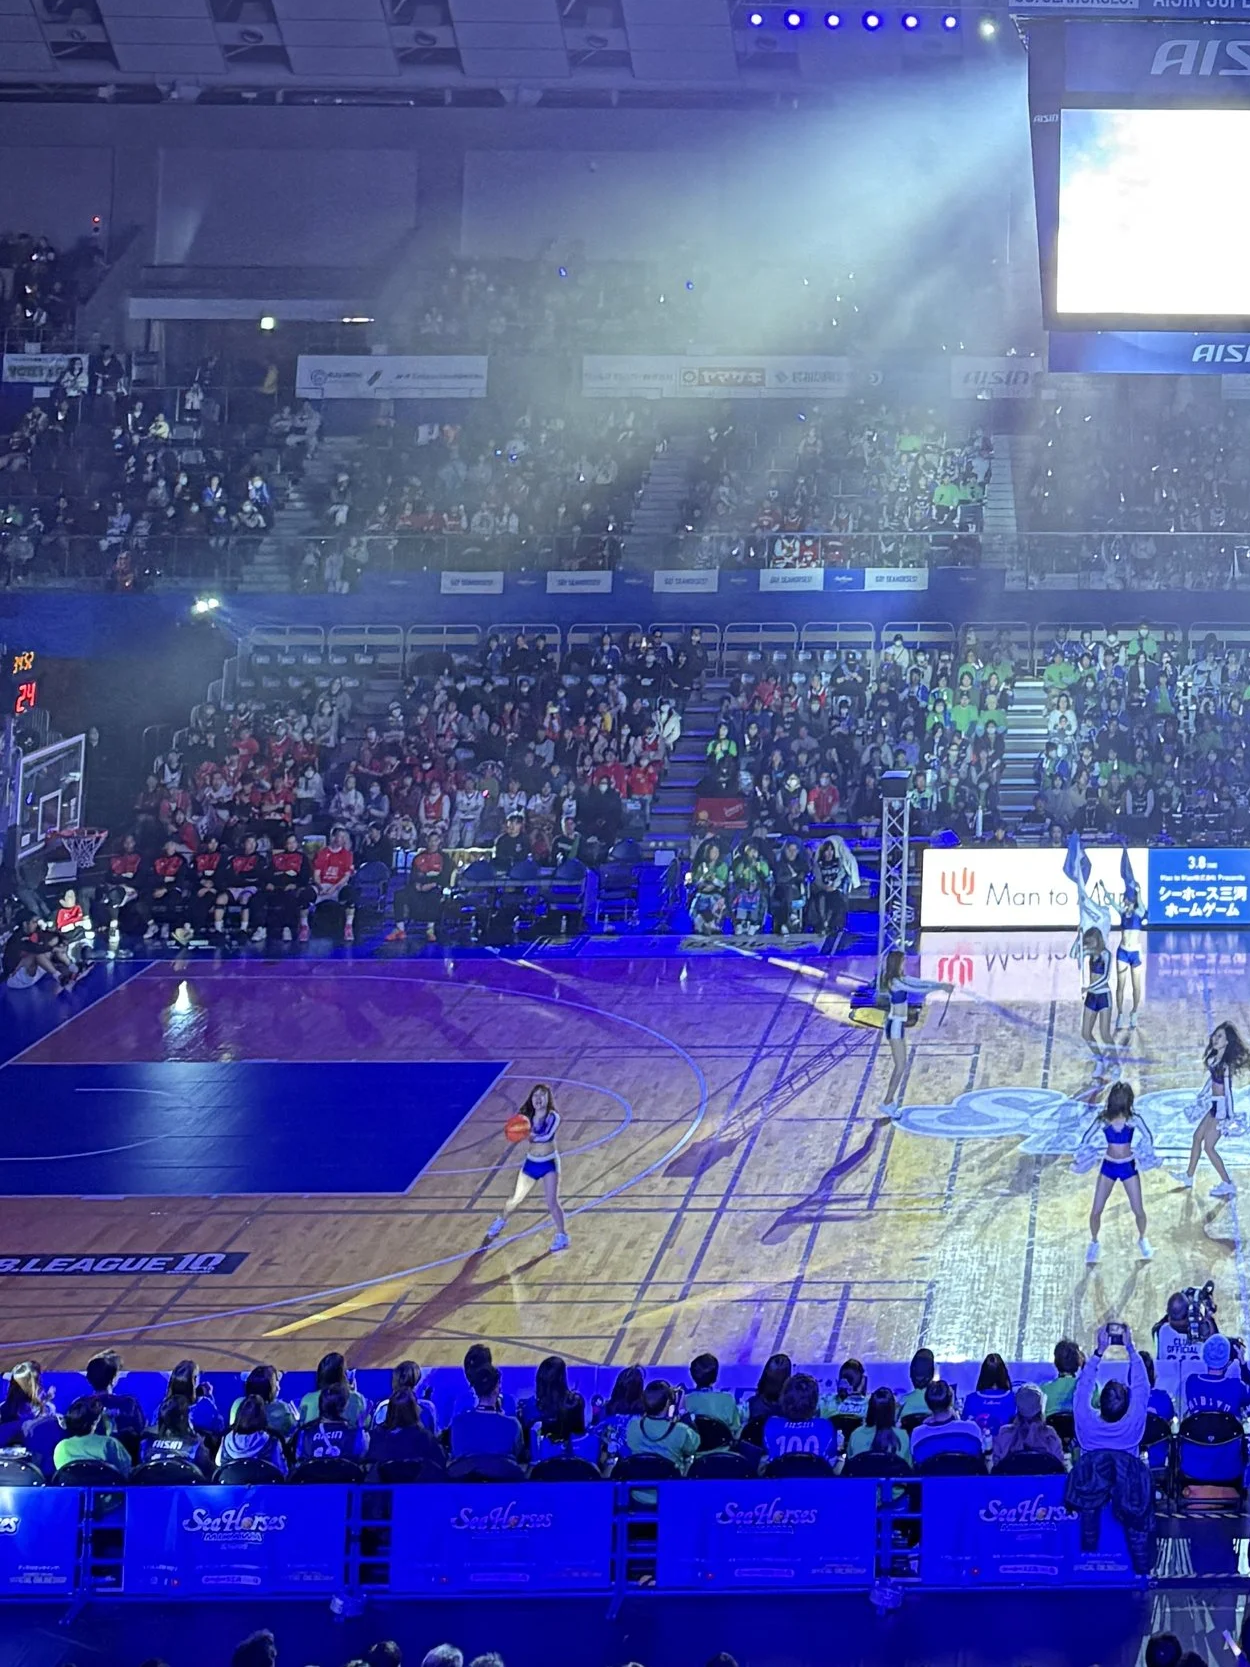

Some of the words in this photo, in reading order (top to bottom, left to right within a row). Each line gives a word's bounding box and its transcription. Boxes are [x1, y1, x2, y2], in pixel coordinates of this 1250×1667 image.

[16, 682, 36, 713] 24
[986, 882, 1040, 906] Man
[1049, 890, 1069, 905] to
[1159, 886, 1248, 902] シーホース三河
[1165, 902, 1240, 918] ホームゲーム
[776, 1435, 820, 1455] 100
[182, 1503, 288, 1532] SeaHorses
[450, 1501, 553, 1530] SeaHorses
[715, 1497, 818, 1525] SeaHorses
